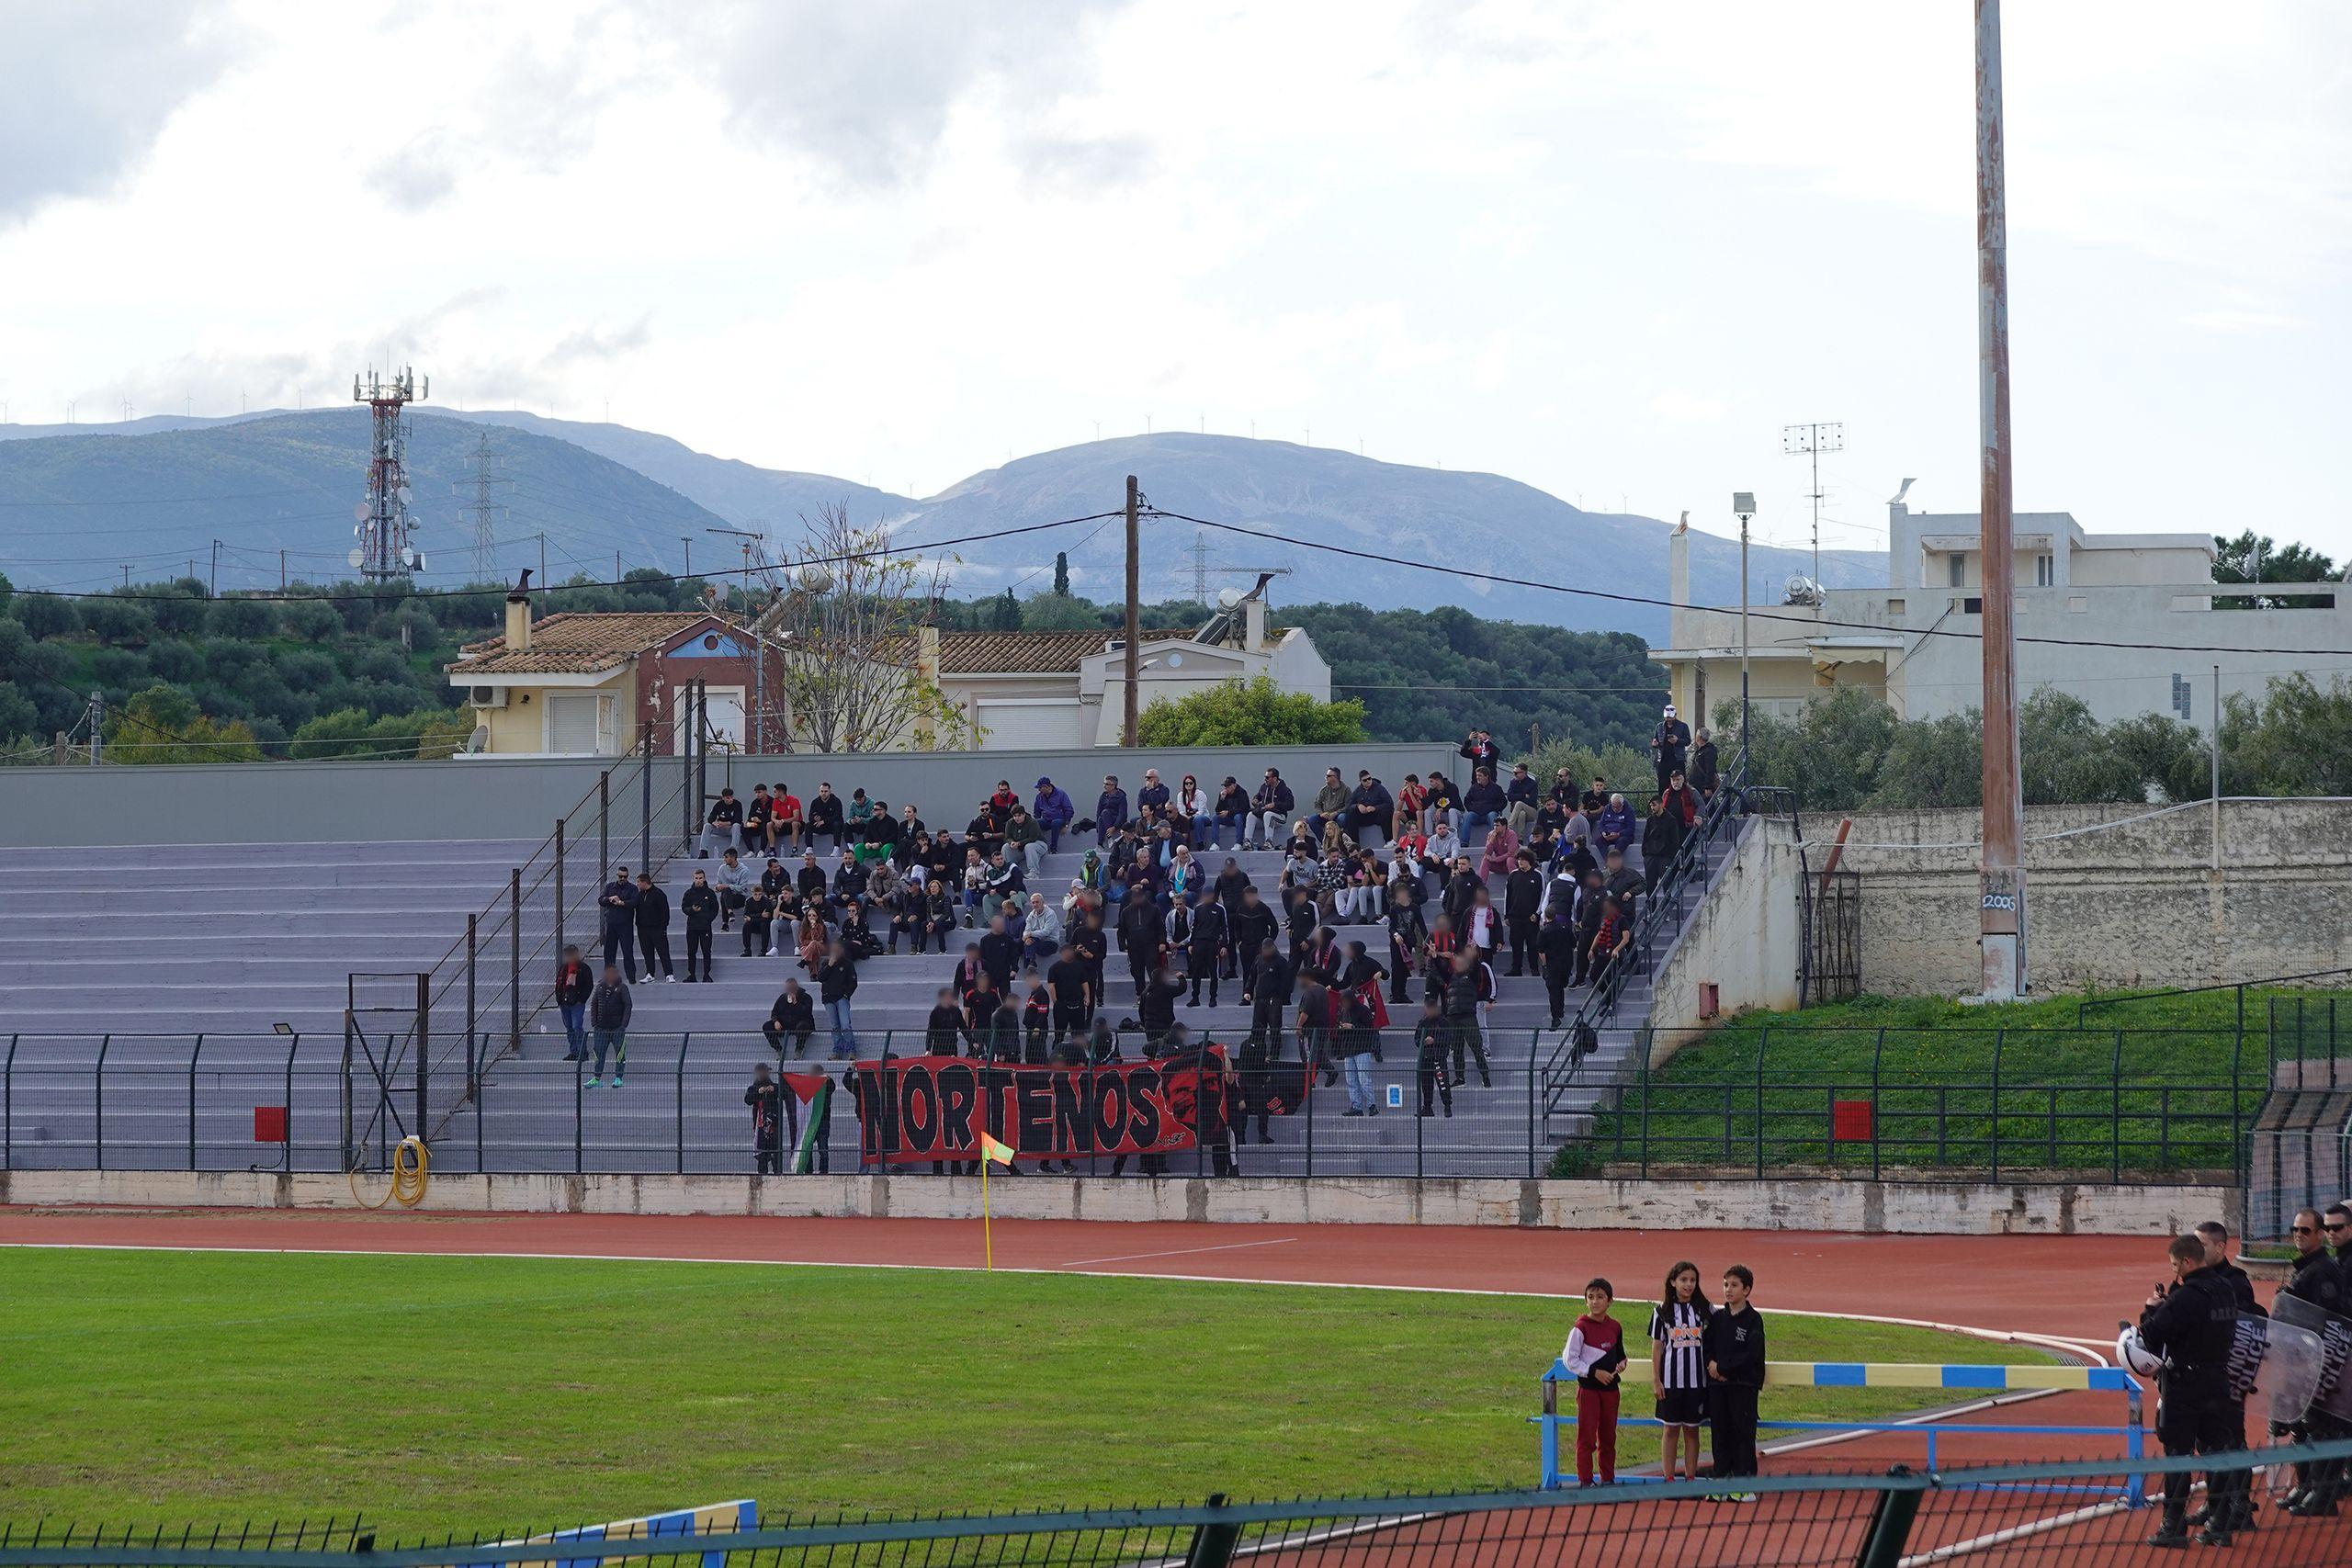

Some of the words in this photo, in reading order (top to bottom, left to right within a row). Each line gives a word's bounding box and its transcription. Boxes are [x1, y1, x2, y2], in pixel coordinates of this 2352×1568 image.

[858, 1064, 1162, 1156] NORTENOS
[2229, 1328, 2267, 1402] POLICE
[2313, 1327, 2352, 1401] POLICE
